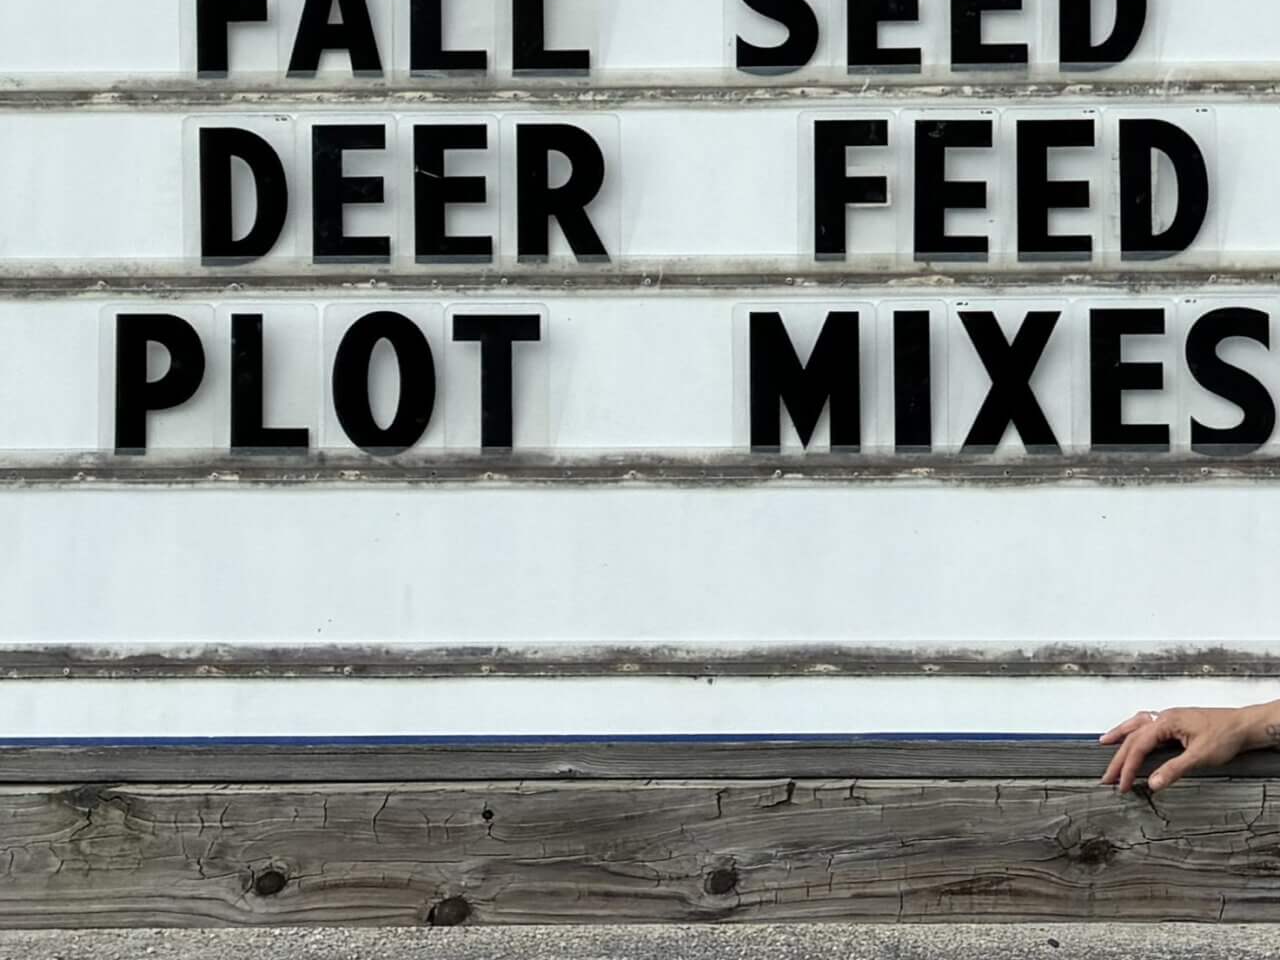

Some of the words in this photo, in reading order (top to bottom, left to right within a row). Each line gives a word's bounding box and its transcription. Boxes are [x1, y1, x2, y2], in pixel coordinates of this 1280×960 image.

[199, 123, 612, 268] DEER
[813, 118, 1210, 263] FEED
[113, 310, 542, 458] PLOT
[749, 306, 1277, 457] MIXES
